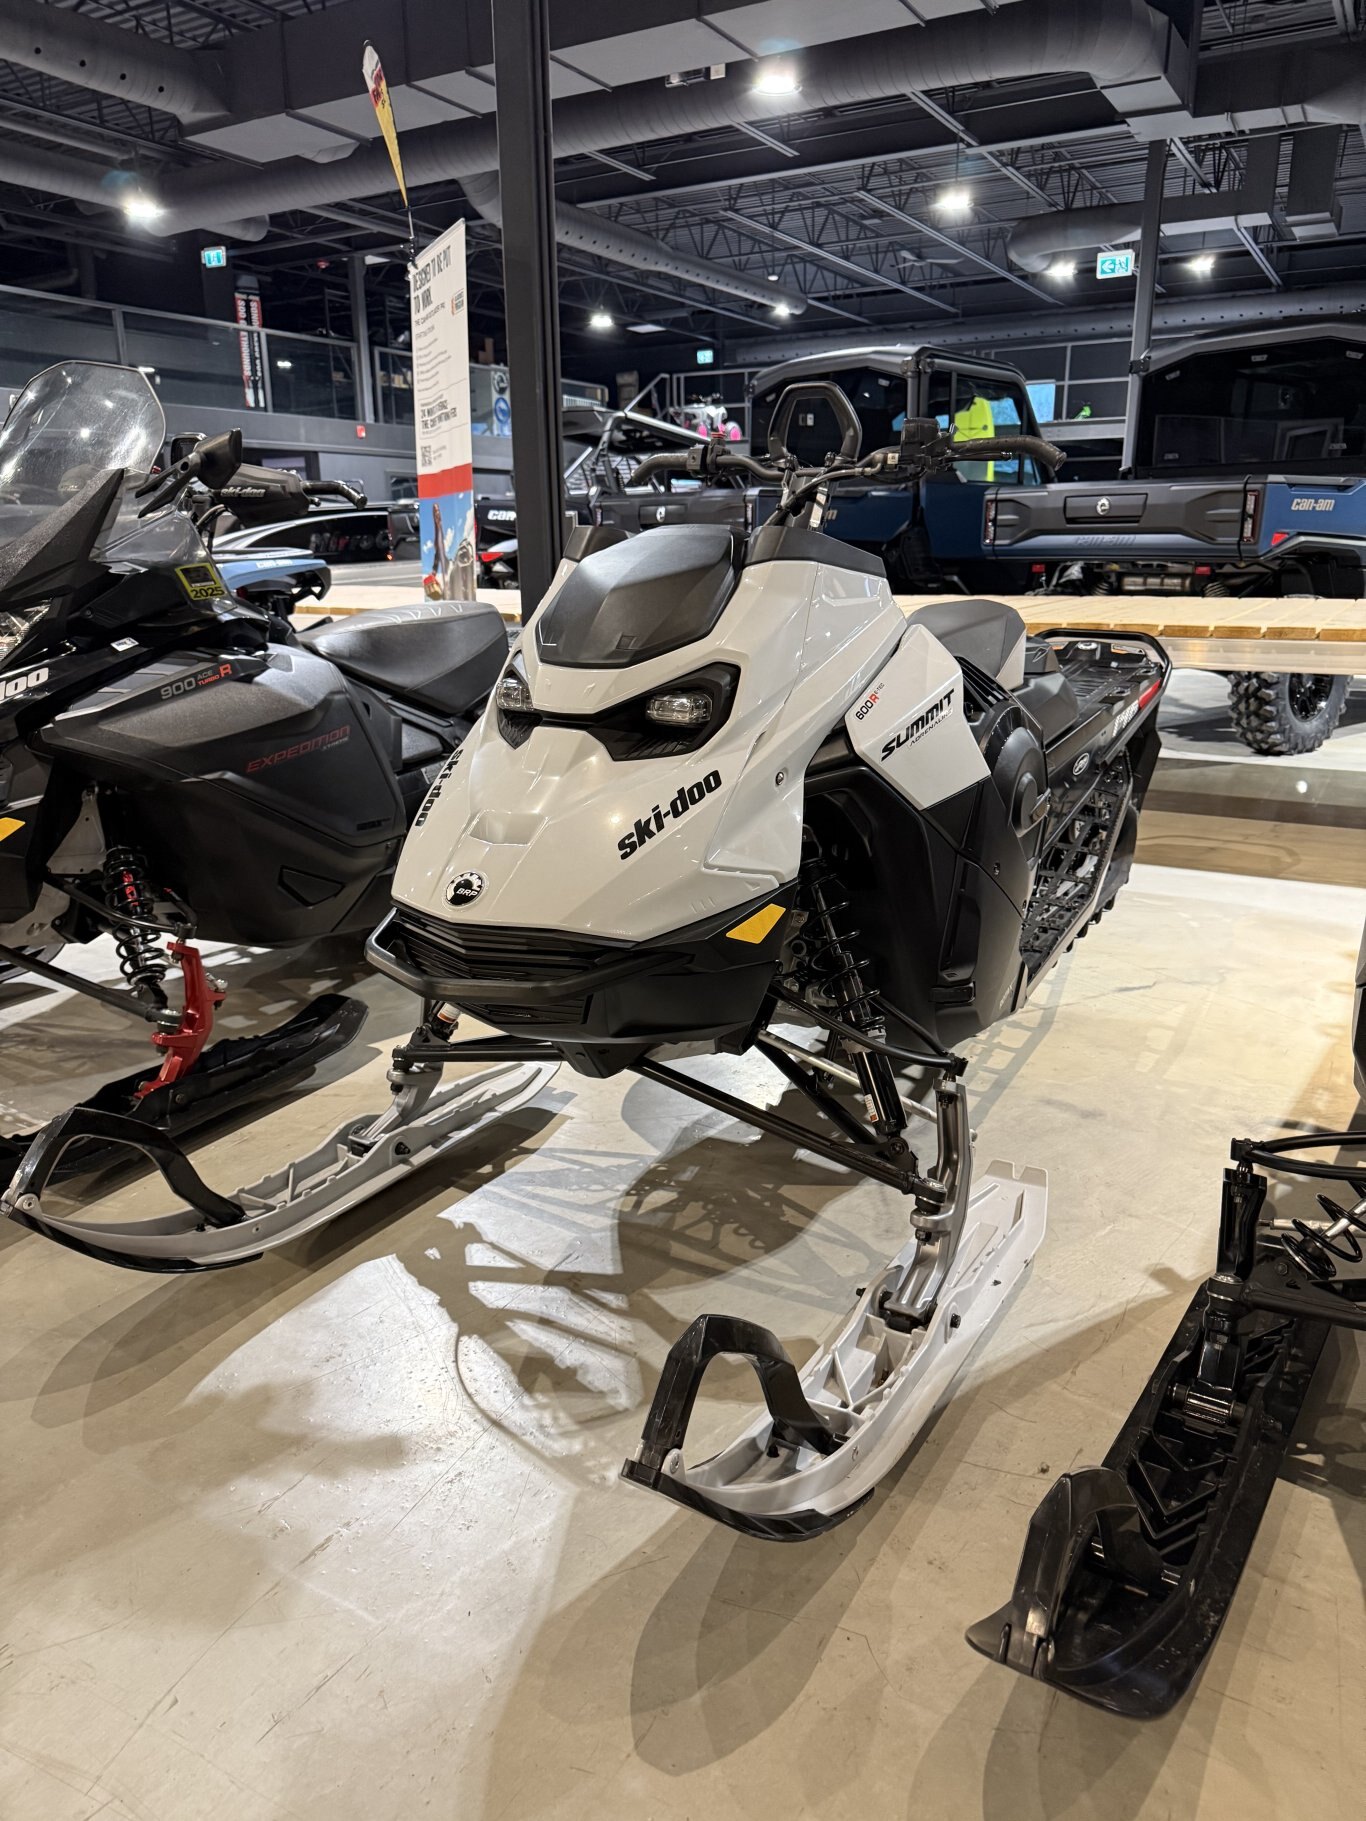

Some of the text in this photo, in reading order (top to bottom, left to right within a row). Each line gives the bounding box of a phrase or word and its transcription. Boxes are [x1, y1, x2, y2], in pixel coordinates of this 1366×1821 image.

[1291, 498, 1335, 511] can-am
[190, 586, 226, 599] 2025
[160, 663, 233, 700] 900 ACE TURBO R
[880, 687, 955, 762] SUMMIT
[246, 724, 351, 774] EXPEDITION
[415, 748, 464, 828] ski-doo
[617, 769, 723, 861] ski-doo
[456, 886, 479, 898] BRP
